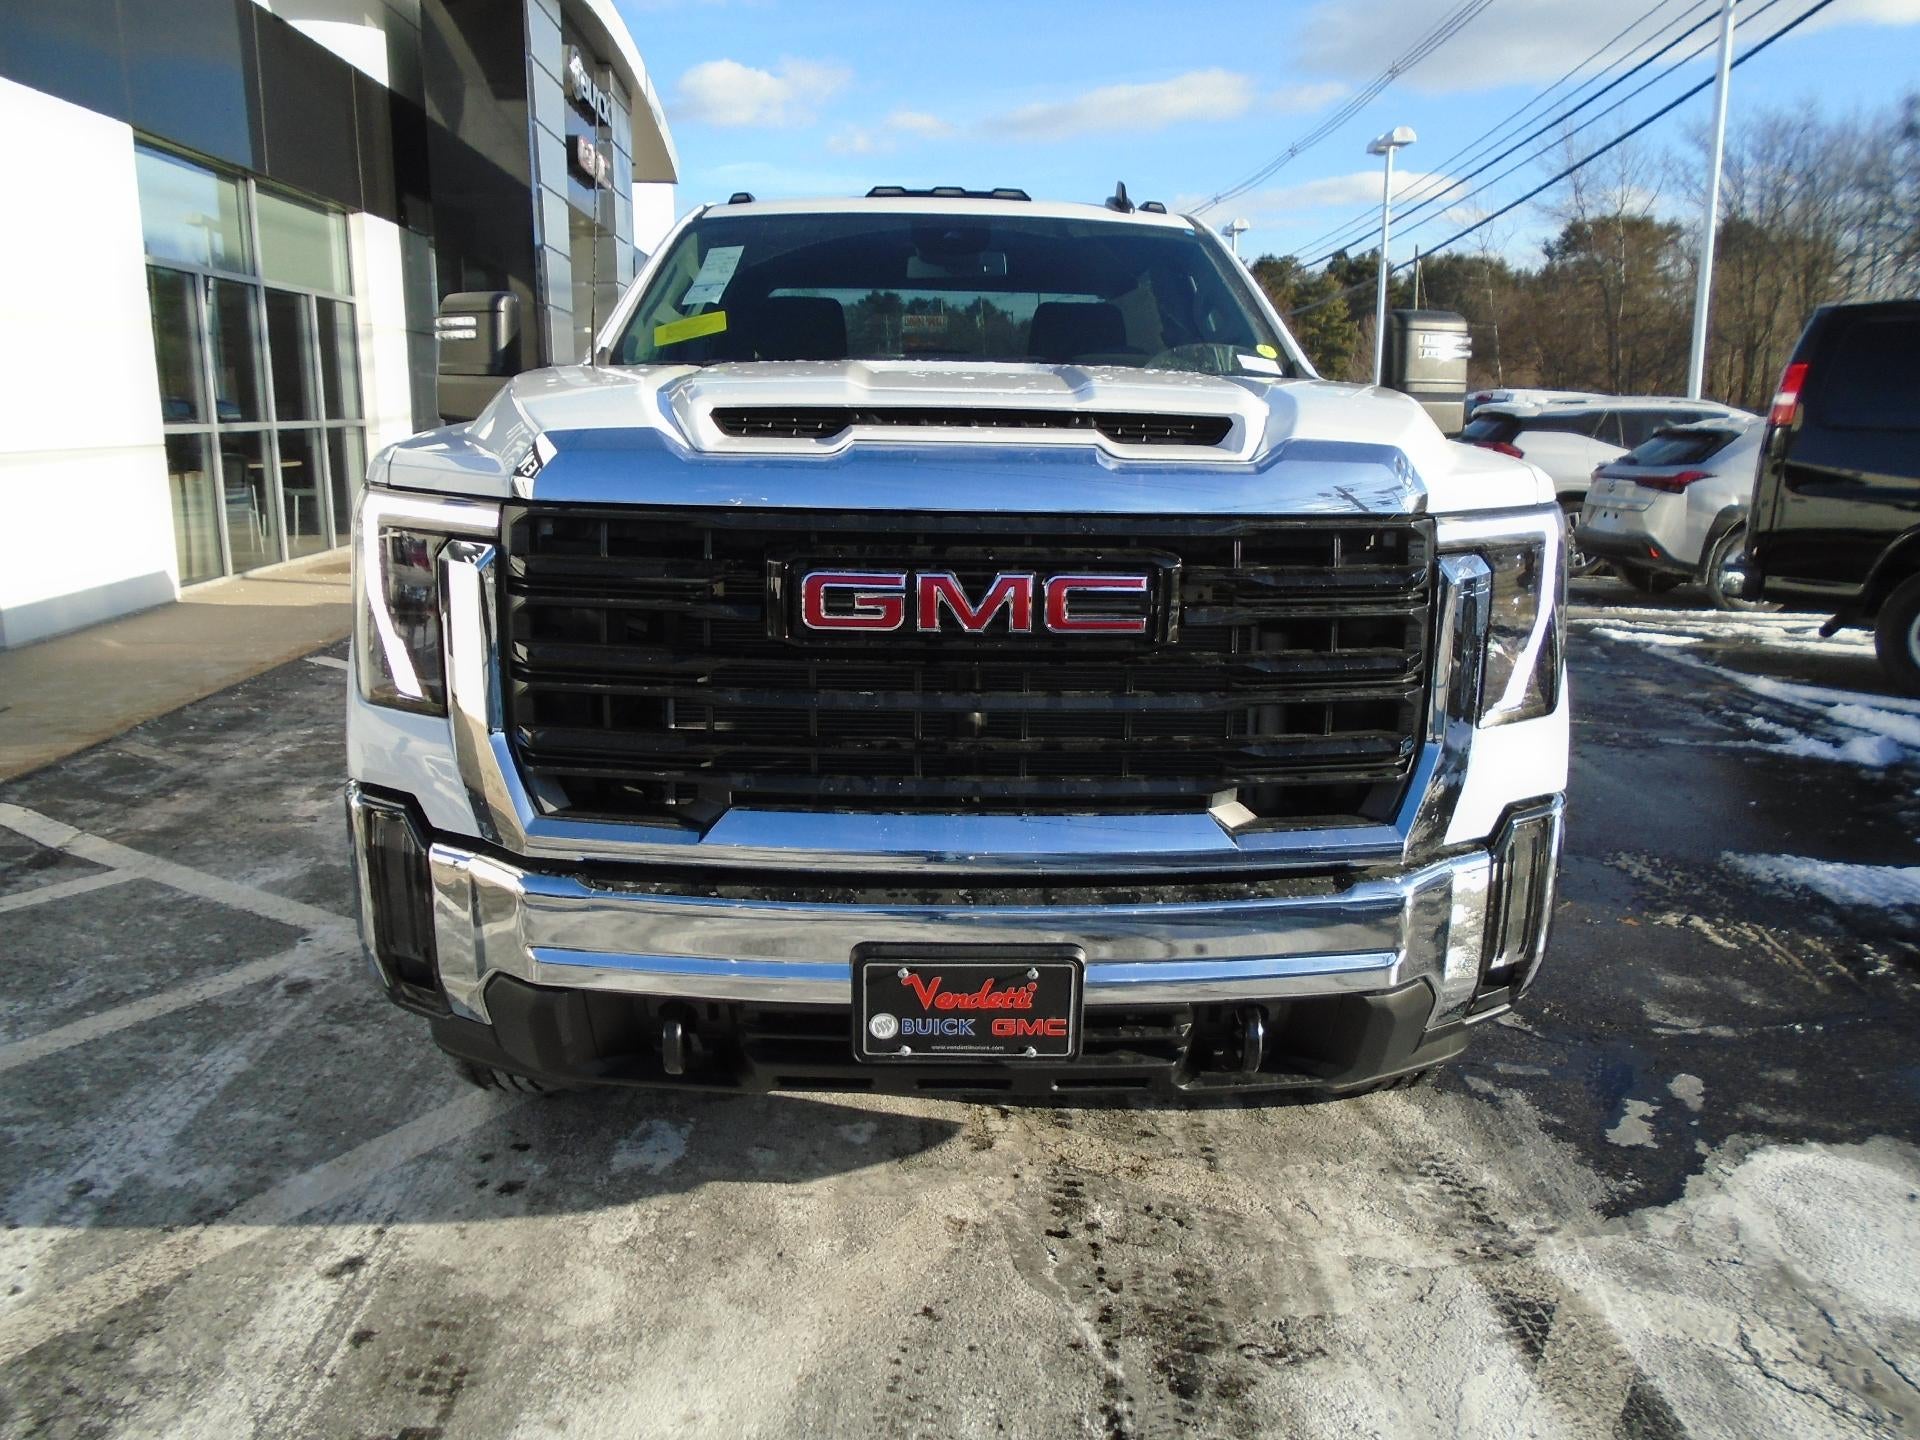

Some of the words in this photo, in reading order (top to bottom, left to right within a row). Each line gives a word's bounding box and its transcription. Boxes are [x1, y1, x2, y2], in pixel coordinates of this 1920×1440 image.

[801, 570, 1148, 633] GMC
[901, 974, 1037, 1009] Vendetti
[901, 1018, 976, 1036] BUICK
[991, 1018, 1067, 1036] GMC
